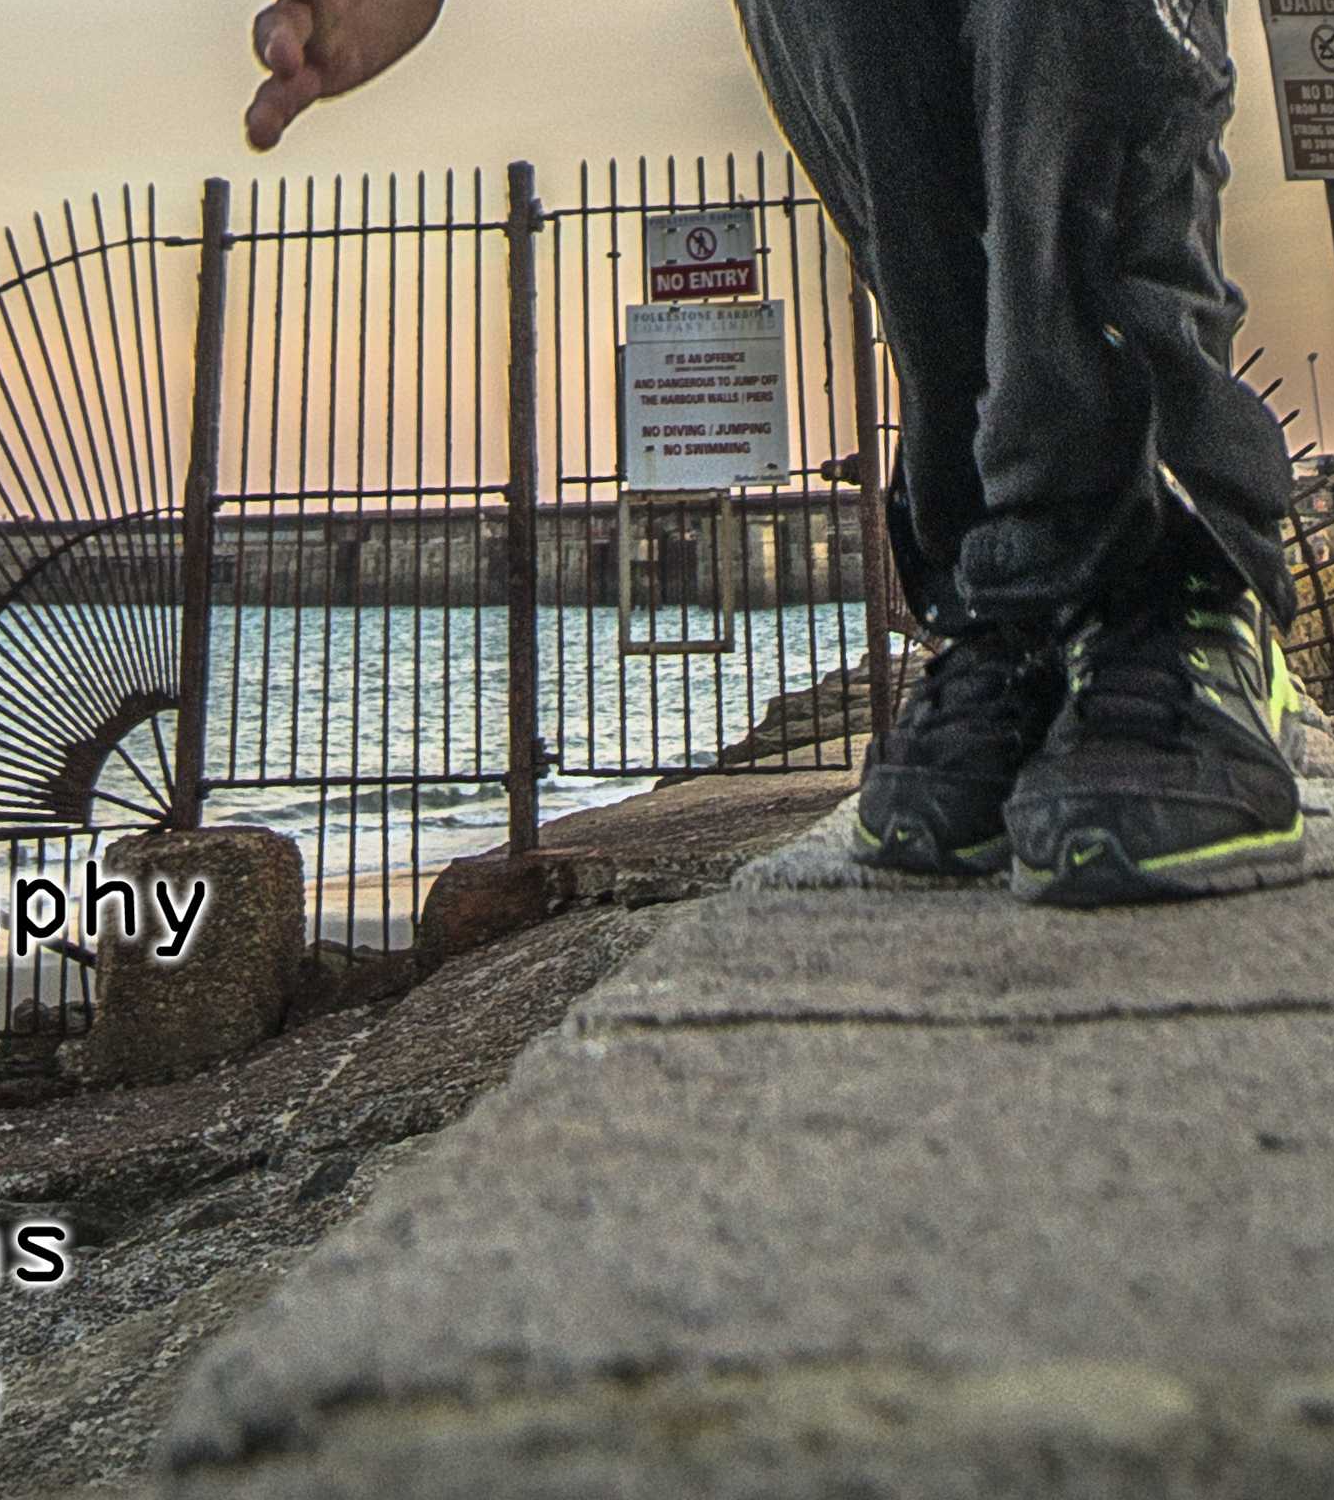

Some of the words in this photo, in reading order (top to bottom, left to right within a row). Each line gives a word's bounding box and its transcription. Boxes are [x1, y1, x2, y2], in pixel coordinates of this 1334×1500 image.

[1301, 84, 1321, 100] NO
[1290, 103, 1318, 115] FROM
[656, 273, 684, 292] NO
[689, 267, 749, 289] ENTRY
[633, 310, 712, 323] FOLKESTONE
[688, 354, 702, 363] AN
[704, 352, 746, 364] OFFENCE
[634, 378, 655, 389] AND
[657, 377, 715, 389] DANGEROUS
[718, 376, 730, 387] TO
[733, 375, 760, 386] JUMP
[761, 374, 779, 385] OFF
[640, 395, 658, 405] THE
[661, 393, 706, 405] HARBOUR
[708, 392, 738, 404] WALLS
[746, 391, 774, 403] PIERS
[642, 426, 660, 437] NO
[663, 425, 706, 437] DIVING
[715, 422, 771, 435] JUMPING
[663, 443, 682, 455] NO
[684, 442, 751, 455] SWIMMING
